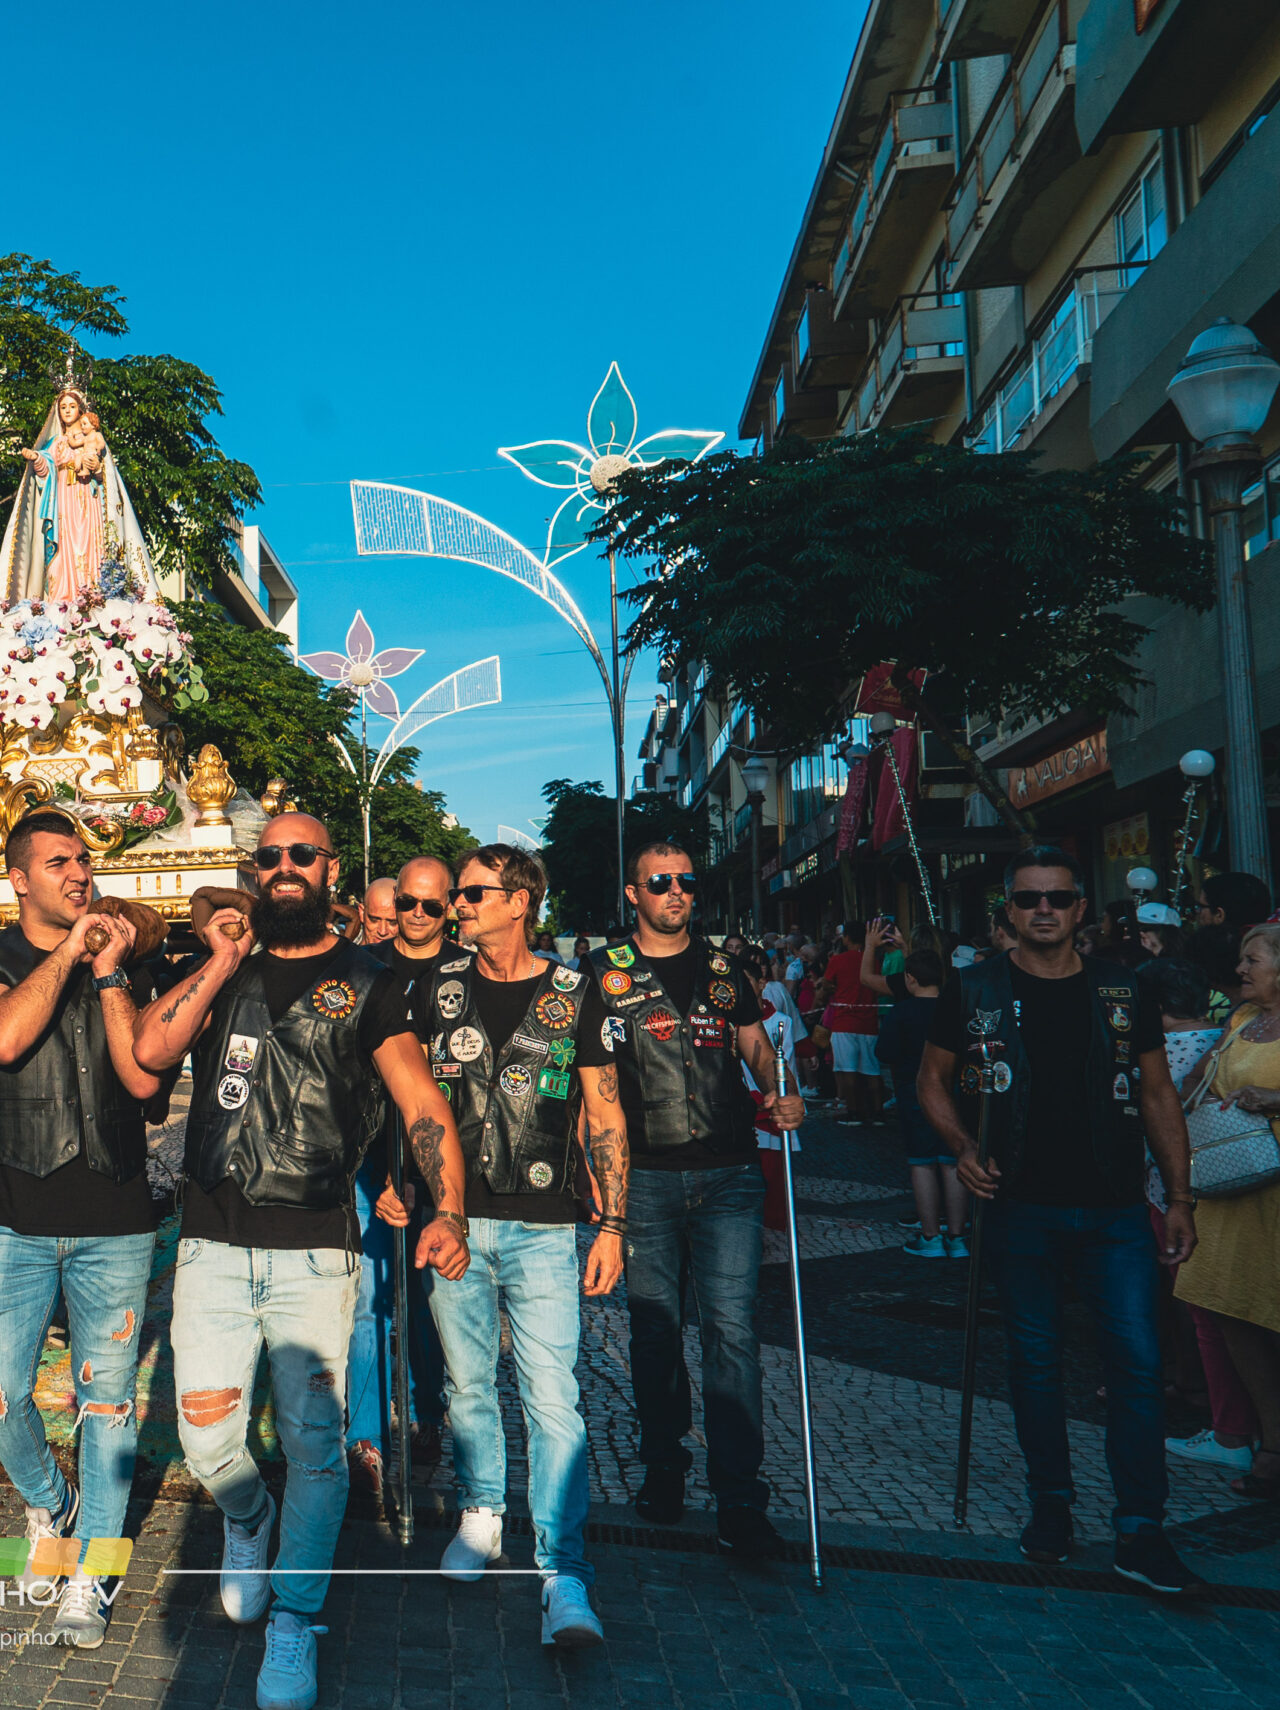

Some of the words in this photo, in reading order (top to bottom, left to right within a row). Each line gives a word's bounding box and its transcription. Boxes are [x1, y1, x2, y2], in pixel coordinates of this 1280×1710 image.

[1032, 738, 1097, 788] VALIGIA
[316, 978, 338, 994] MOTO
[340, 980, 357, 1007] CLUBE
[536, 992, 555, 1006] MOTO
[557, 994, 575, 1017] CLUBE
[312, 994, 352, 1020] ESPINHO
[535, 1006, 573, 1030] ESPINHO
[640, 1022, 650, 1031] THE
[651, 1018, 682, 1030] OFFSPRING
